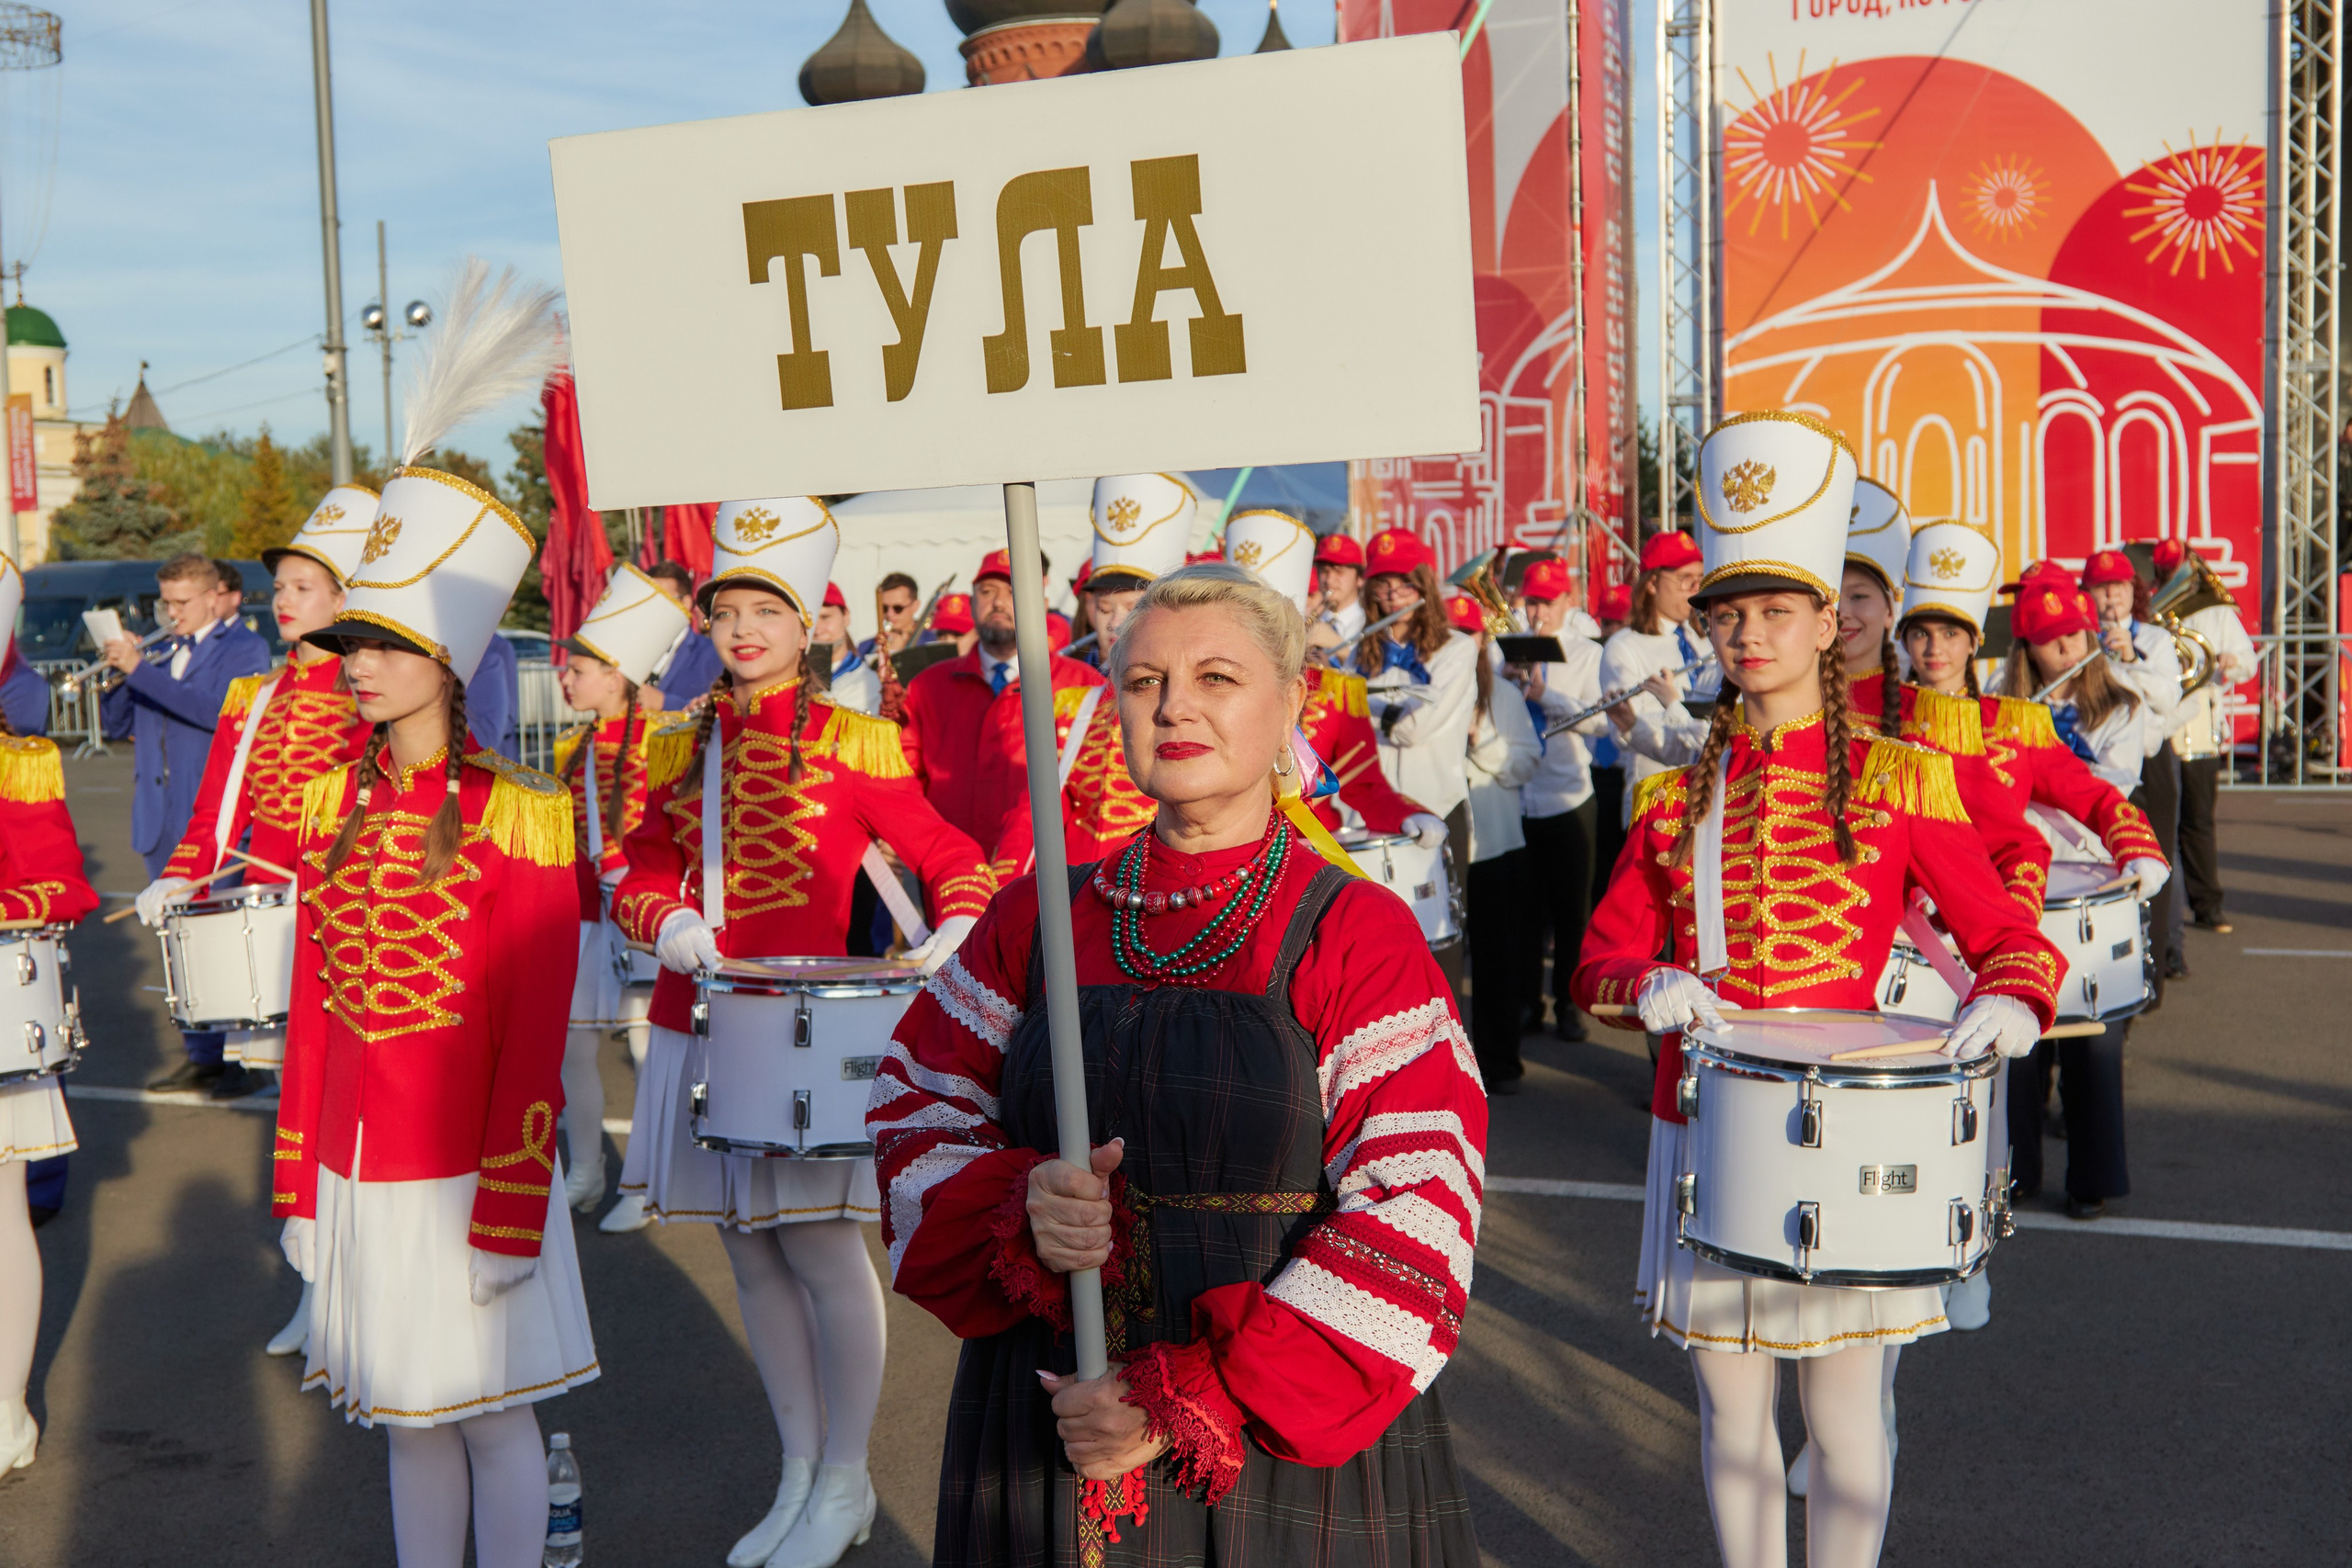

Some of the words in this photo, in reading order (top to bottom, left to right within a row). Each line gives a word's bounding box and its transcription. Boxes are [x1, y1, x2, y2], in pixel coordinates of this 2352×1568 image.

[741, 153, 1247, 411] ТУЛА
[843, 1060, 877, 1077] Flight
[1863, 1170, 1908, 1191] Flight
